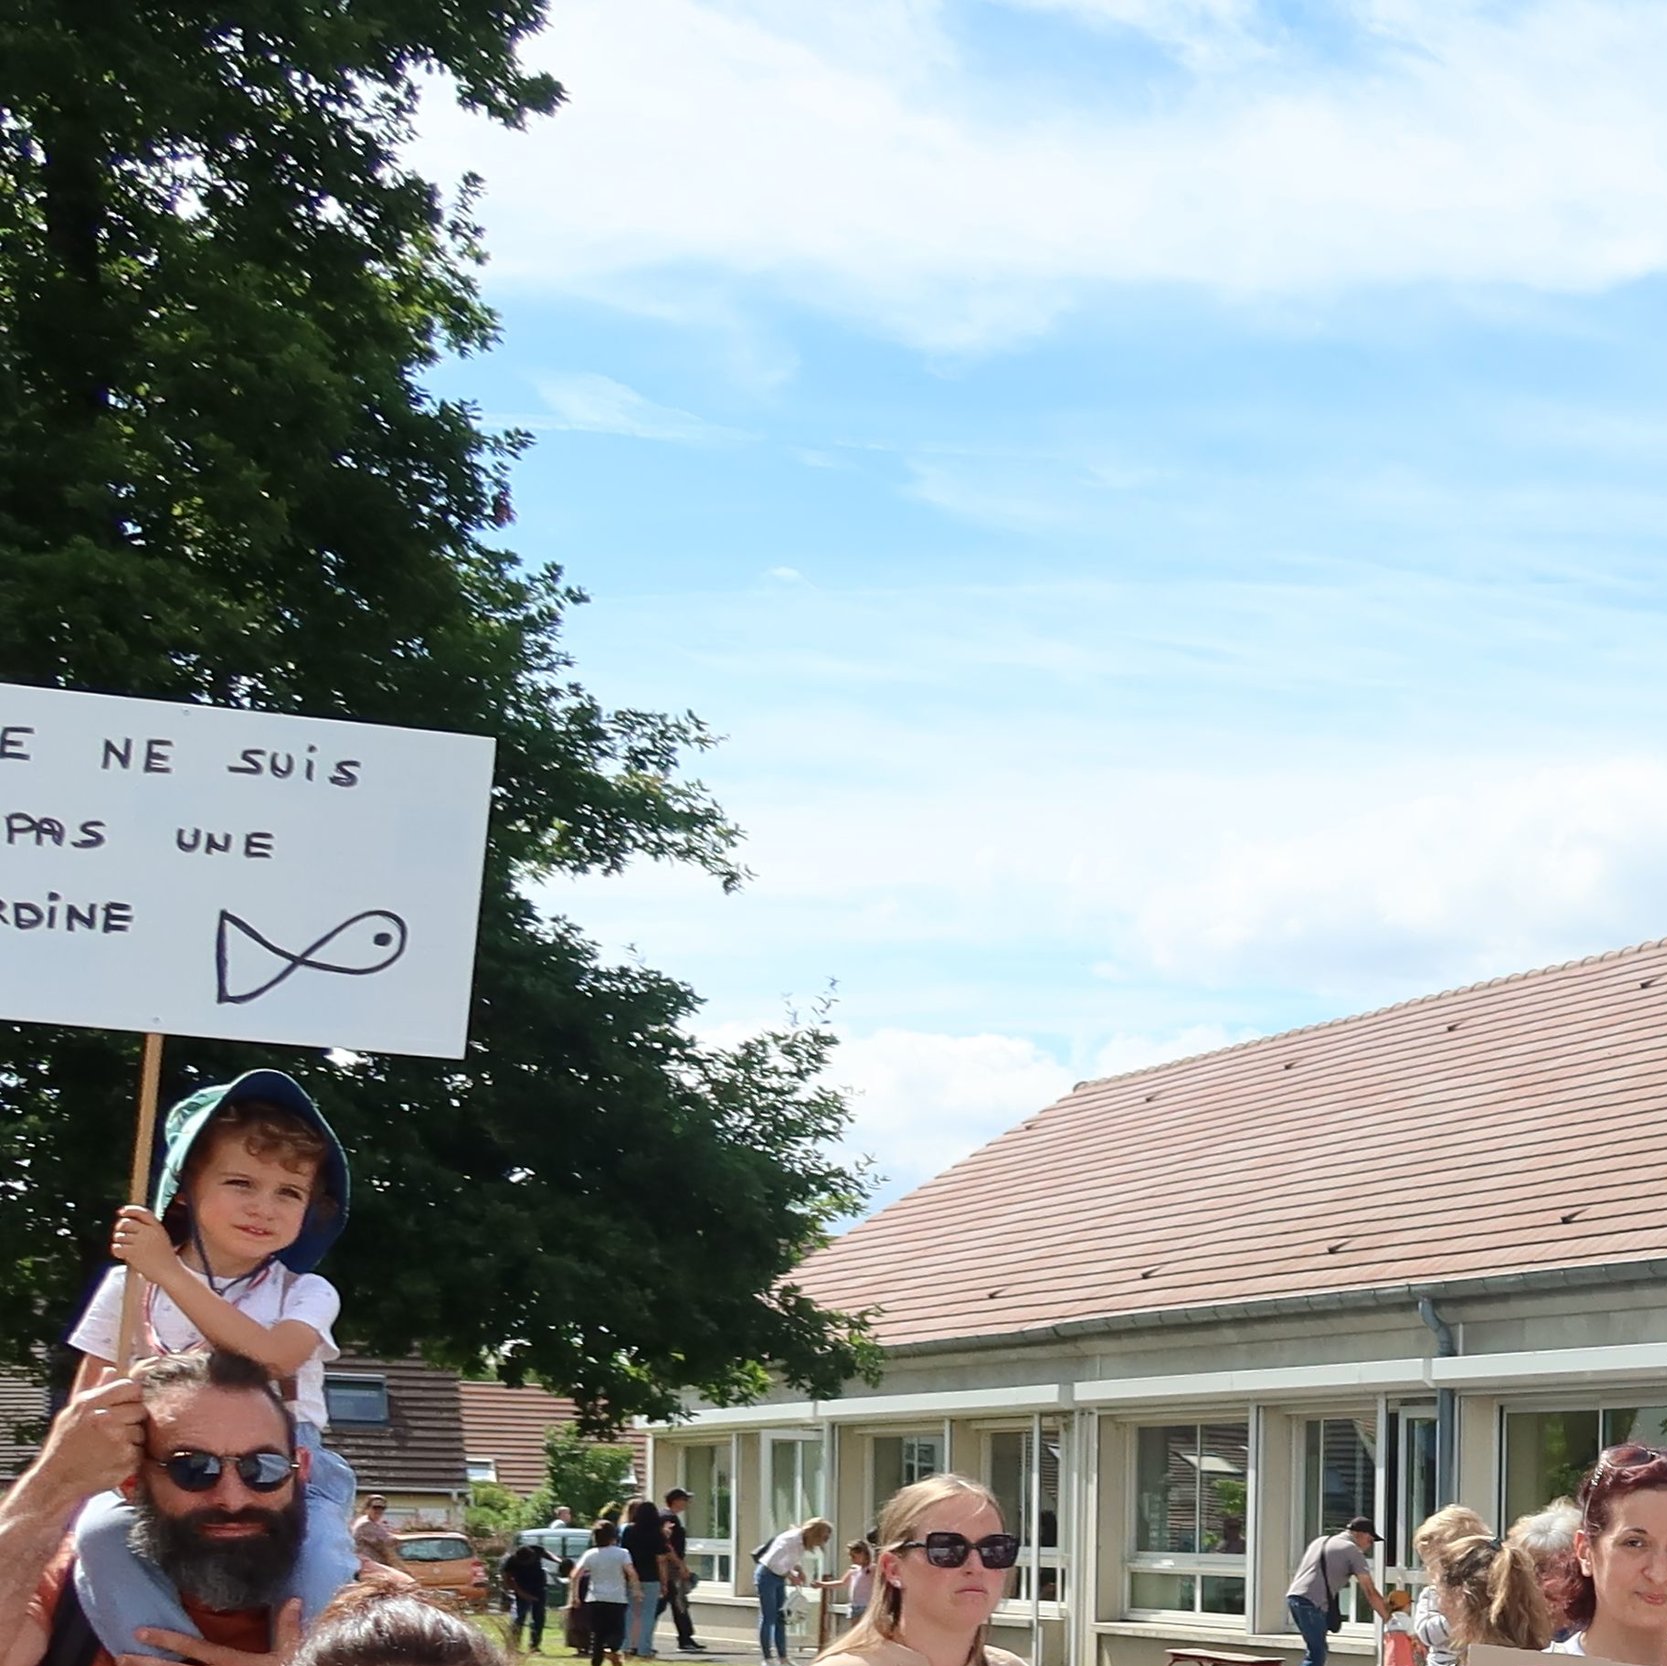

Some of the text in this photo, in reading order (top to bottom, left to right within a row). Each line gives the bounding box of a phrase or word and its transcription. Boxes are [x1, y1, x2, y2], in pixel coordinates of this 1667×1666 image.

[0, 726, 35, 761] E
[101, 736, 175, 775] NE
[4, 811, 275, 859] PAS UNE
